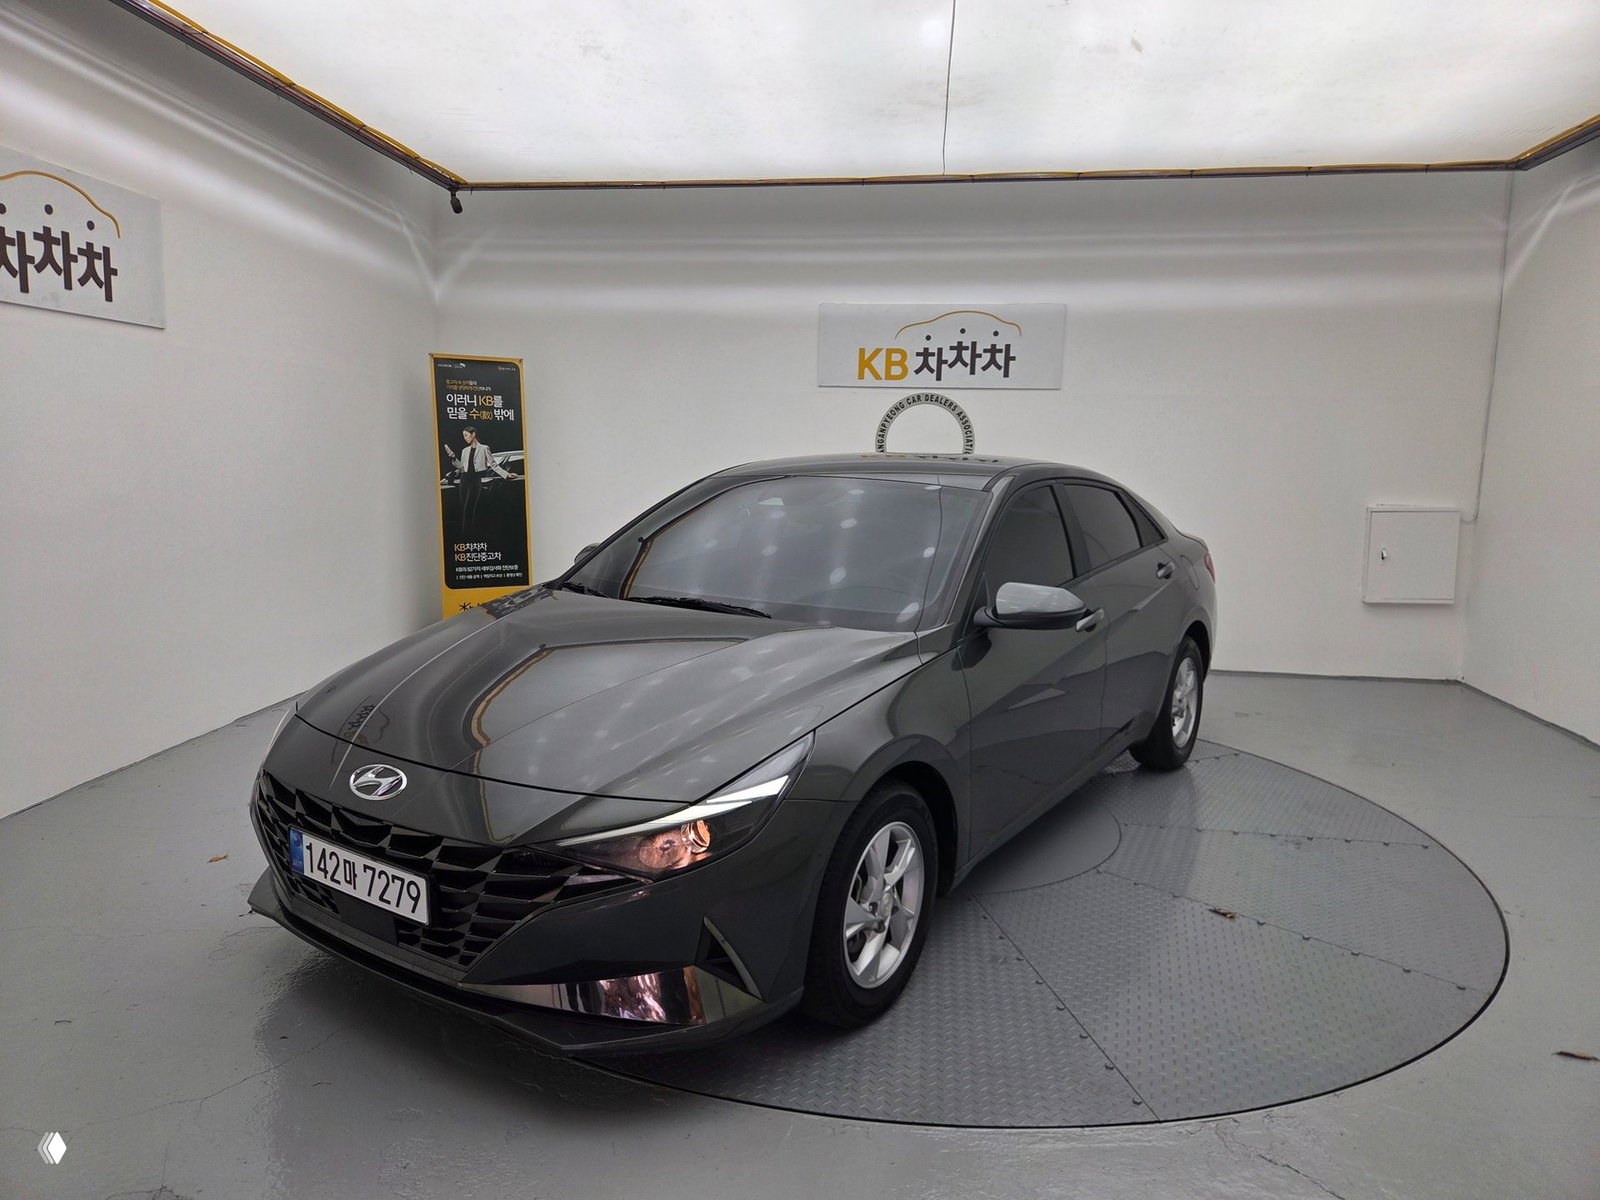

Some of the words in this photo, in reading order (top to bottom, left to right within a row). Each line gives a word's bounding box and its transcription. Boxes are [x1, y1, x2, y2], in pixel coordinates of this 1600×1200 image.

[857, 347, 909, 381] KB
[913, 328, 1016, 381] 차차차
[446, 393, 477, 407] 이러니
[478, 395, 504, 408] KB를
[906, 394, 922, 406] CAR
[924, 394, 958, 412] DEALERS
[446, 406, 468, 420] 믿을
[493, 409, 515, 421] 밖에
[363, 864, 421, 914] 7279
